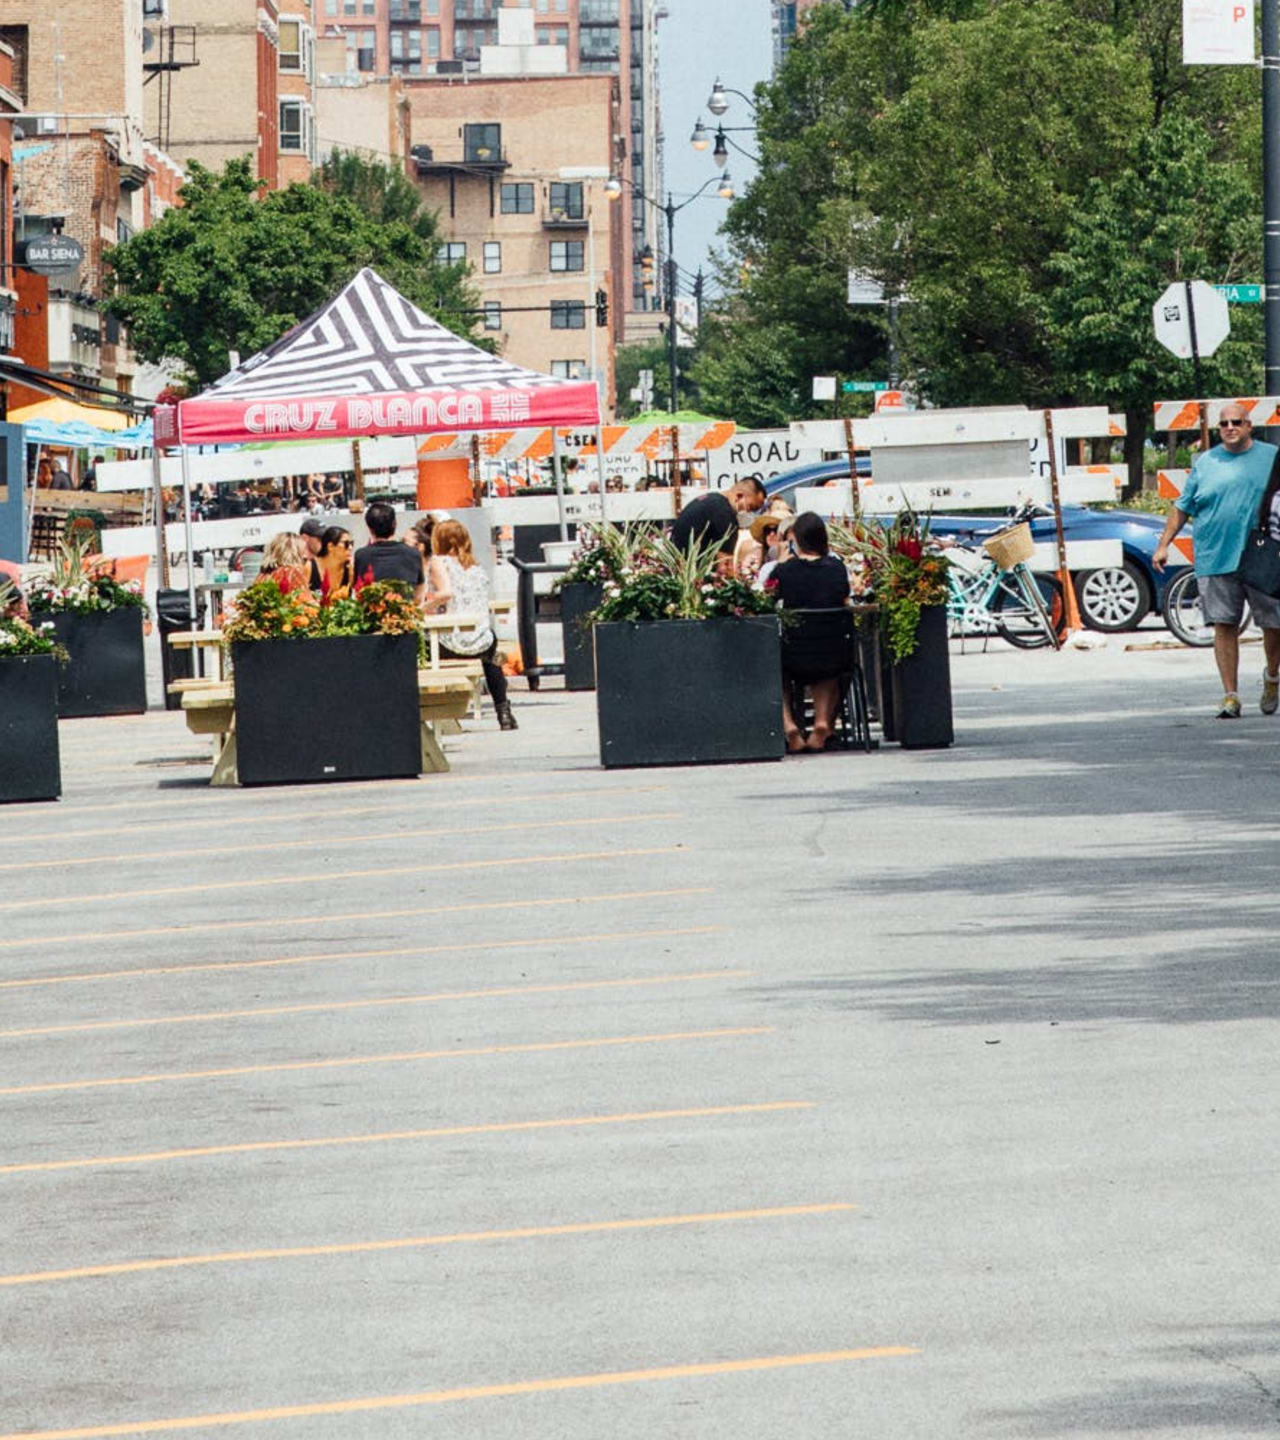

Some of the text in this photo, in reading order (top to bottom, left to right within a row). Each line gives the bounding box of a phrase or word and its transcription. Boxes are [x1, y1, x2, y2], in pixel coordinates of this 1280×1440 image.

[29, 248, 80, 260] BAR SIENA
[1217, 284, 1239, 300] RIA
[243, 394, 483, 434] CRUZ BLANCA
[730, 441, 800, 463] ROAD
